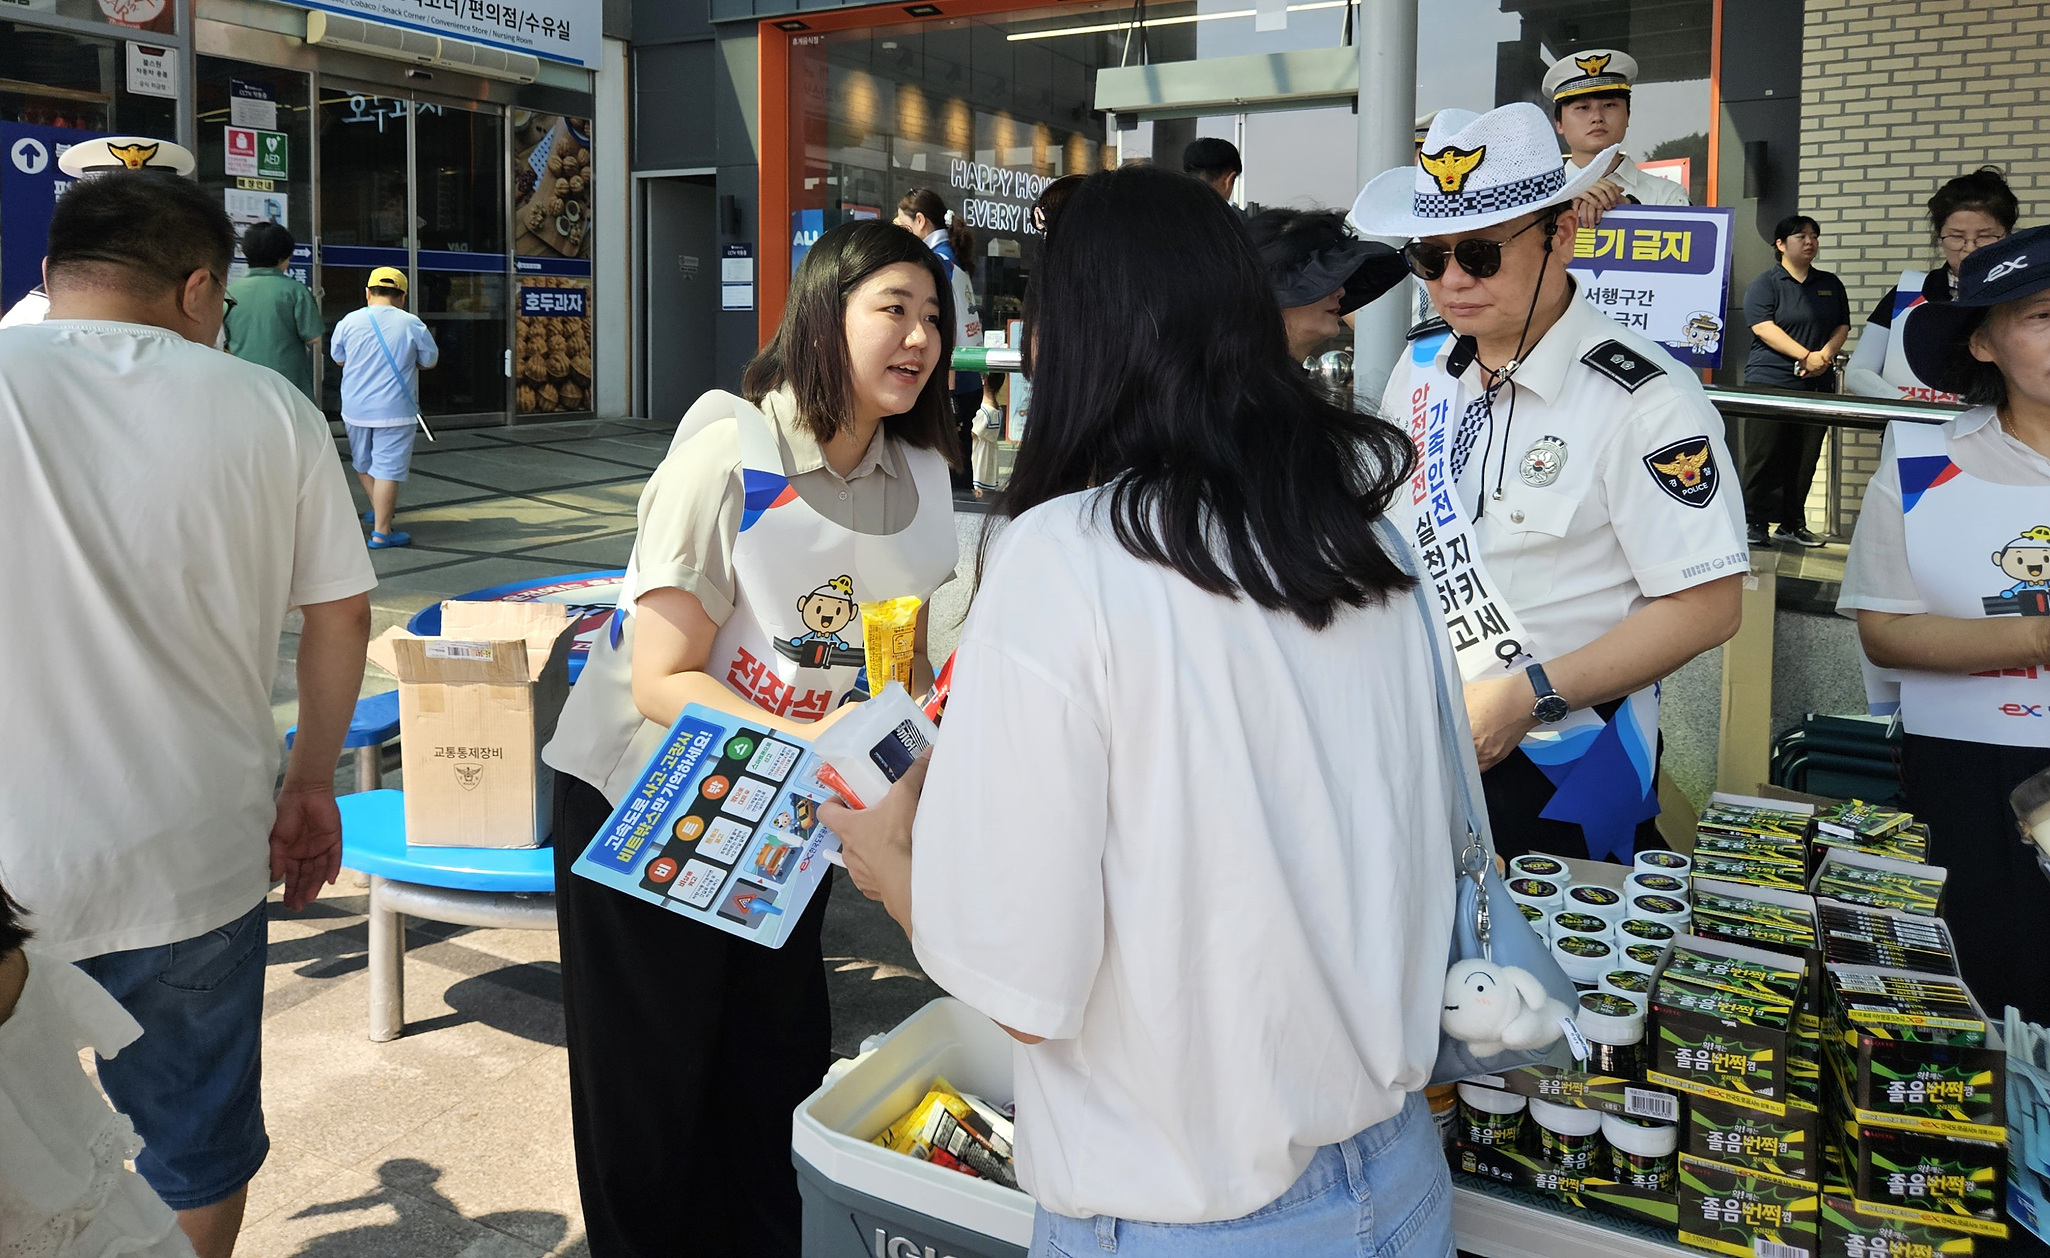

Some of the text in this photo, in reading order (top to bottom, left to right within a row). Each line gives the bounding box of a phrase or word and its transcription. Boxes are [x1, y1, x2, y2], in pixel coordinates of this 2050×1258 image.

[382, 4, 403, 16] Snack
[403, 9, 426, 21] Corner
[431, 16, 471, 32] Convenience
[472, 24, 489, 36] Store
[492, 30, 516, 43] Nursing
[516, 35, 534, 46] Room
[264, 153, 280, 166] AED
[950, 158, 1013, 197] HAPPY
[963, 198, 1020, 232] EVERY
[1632, 229, 1692, 262] 금지
[1983, 255, 2028, 283] ex
[524, 292, 583, 313] 호두과자
[1585, 287, 1655, 307] 서행구간
[1427, 398, 1456, 529] 가족안전
[1681, 482, 1709, 496] POLICE
[1998, 703, 2043, 718] ex
[433, 746, 503, 760] 교통통제장비
[732, 739, 748, 755] 스
[616, 727, 713, 865] 비트밖스만 기억하세요!
[707, 779, 723, 796] 밖
[603, 793, 649, 853] 고속도로
[681, 818, 698, 837] 트
[653, 860, 671, 879] 비
[1706, 1130, 1788, 1157] 졸음번쩍껌
[1701, 1196, 1792, 1228] 졸음번쩍껌
